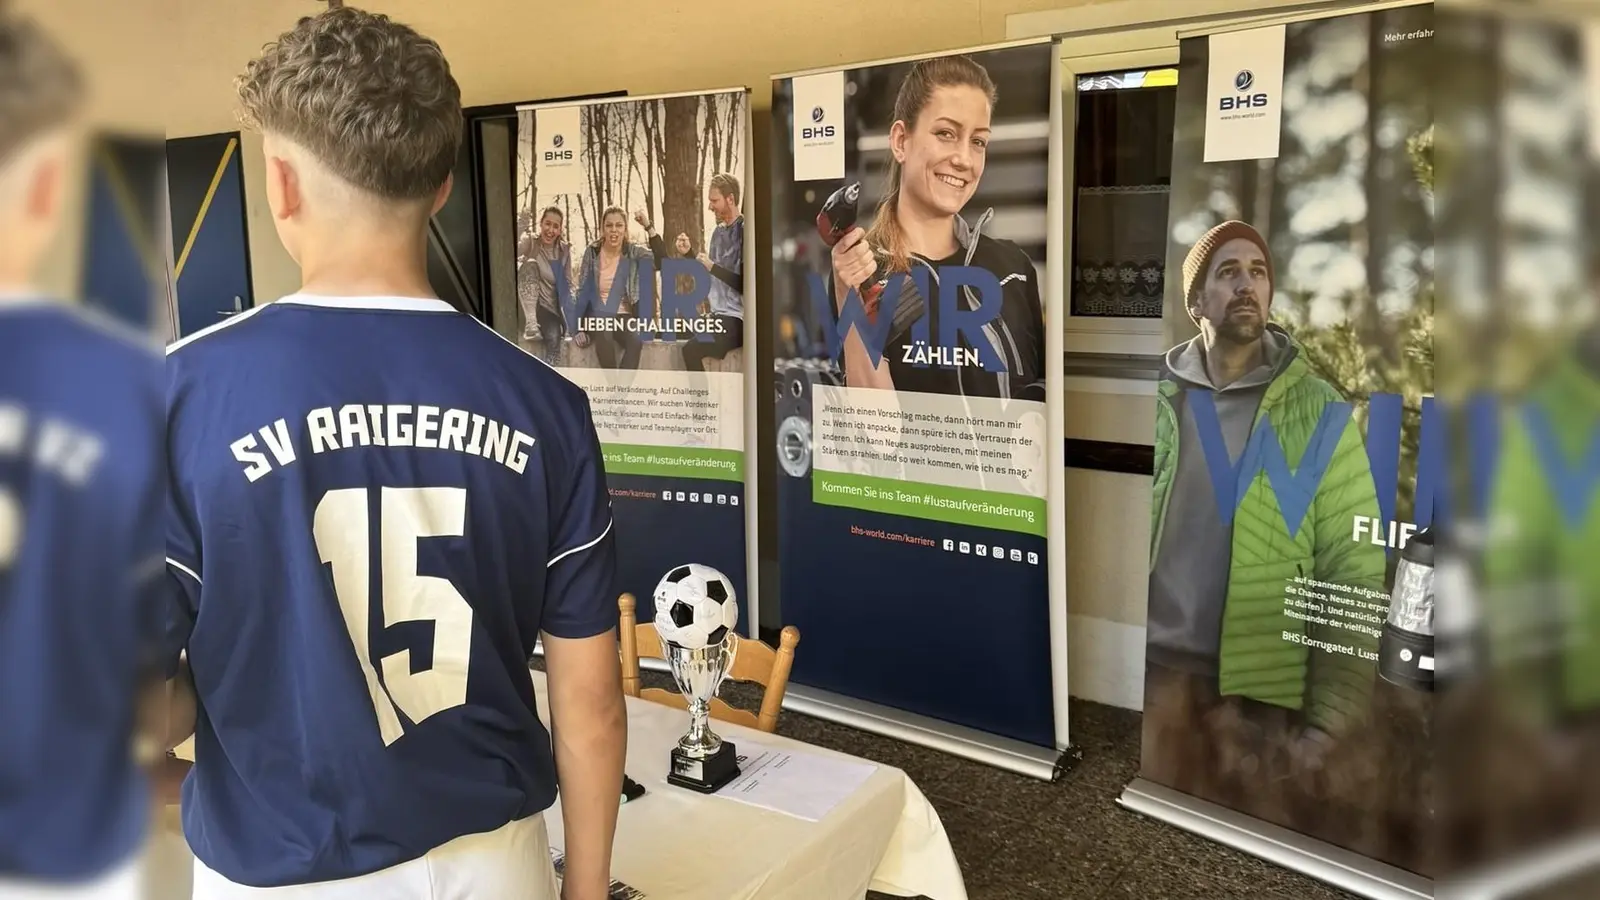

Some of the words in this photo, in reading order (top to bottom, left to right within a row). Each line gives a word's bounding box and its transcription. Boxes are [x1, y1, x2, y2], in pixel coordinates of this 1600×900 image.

[1384, 32, 1405, 42] Mehr
[1220, 93, 1268, 110] BHS
[802, 126, 835, 138] BHS
[545, 150, 573, 160] BHS
[550, 257, 716, 343] WIR
[577, 316, 624, 332] LIEBEN
[626, 317, 727, 334] CHALLENGES.
[806, 265, 1009, 373] WIR
[902, 340, 984, 368] ZÄHLEN.
[672, 387, 709, 397] Challenges
[843, 406, 855, 414] ich
[856, 407, 876, 416] einen
[877, 408, 913, 422] Vorschlag
[914, 413, 942, 423] mache,
[944, 415, 964, 424] dann
[966, 417, 984, 426] hört
[986, 420, 1005, 428] man
[655, 424, 692, 434] Teamplayer
[833, 419, 853, 428] Wenn
[854, 421, 865, 429] ich
[867, 424, 899, 434] anpacke,
[900, 427, 920, 435] dann
[922, 428, 943, 438] spüre
[945, 430, 957, 439] ich
[959, 432, 974, 440] das
[975, 433, 1017, 444] Vertrauen
[1019, 437, 1033, 446] der
[229, 418, 296, 483] SV
[306, 404, 535, 475] RAIGERING
[867, 436, 883, 445] kann
[885, 439, 908, 448] Neues
[910, 443, 963, 456] ausprobieren,
[965, 448, 978, 456] mit
[981, 449, 1012, 459] meinen
[609, 453, 622, 462] ins
[624, 453, 645, 463] Team
[647, 454, 737, 472] #lustaufveränderung
[822, 446, 849, 456] Stärken
[883, 453, 897, 462] Und
[910, 456, 925, 465] weit
[927, 458, 963, 470] kommen,
[965, 462, 979, 471] wie
[981, 464, 994, 473] ich
[822, 481, 863, 496] Kommen
[864, 485, 878, 498] Sie
[879, 487, 894, 501] ins
[895, 490, 921, 504] Team
[923, 496, 1035, 523] #lustaufveränderung
[850, 525, 935, 547] bhs-world.com/karriere
[1352, 515, 1428, 549] FLIE
[1285, 586, 1297, 594] die
[1298, 587, 1328, 602] Chance,
[1330, 594, 1355, 606] Neues
[1368, 602, 1389, 614] erpro
[1308, 579, 1352, 593] spannende
[1352, 586, 1391, 600] Aufgaben
[313, 486, 473, 747] 15
[1284, 608, 1328, 626] Miteinander
[1330, 619, 1343, 628] der
[1328, 606, 1343, 616] Und
[1345, 610, 1381, 624] natürlich
[1282, 631, 1300, 644] BHS
[1302, 635, 1356, 656] Corrugated.
[1358, 648, 1379, 661] Lust
